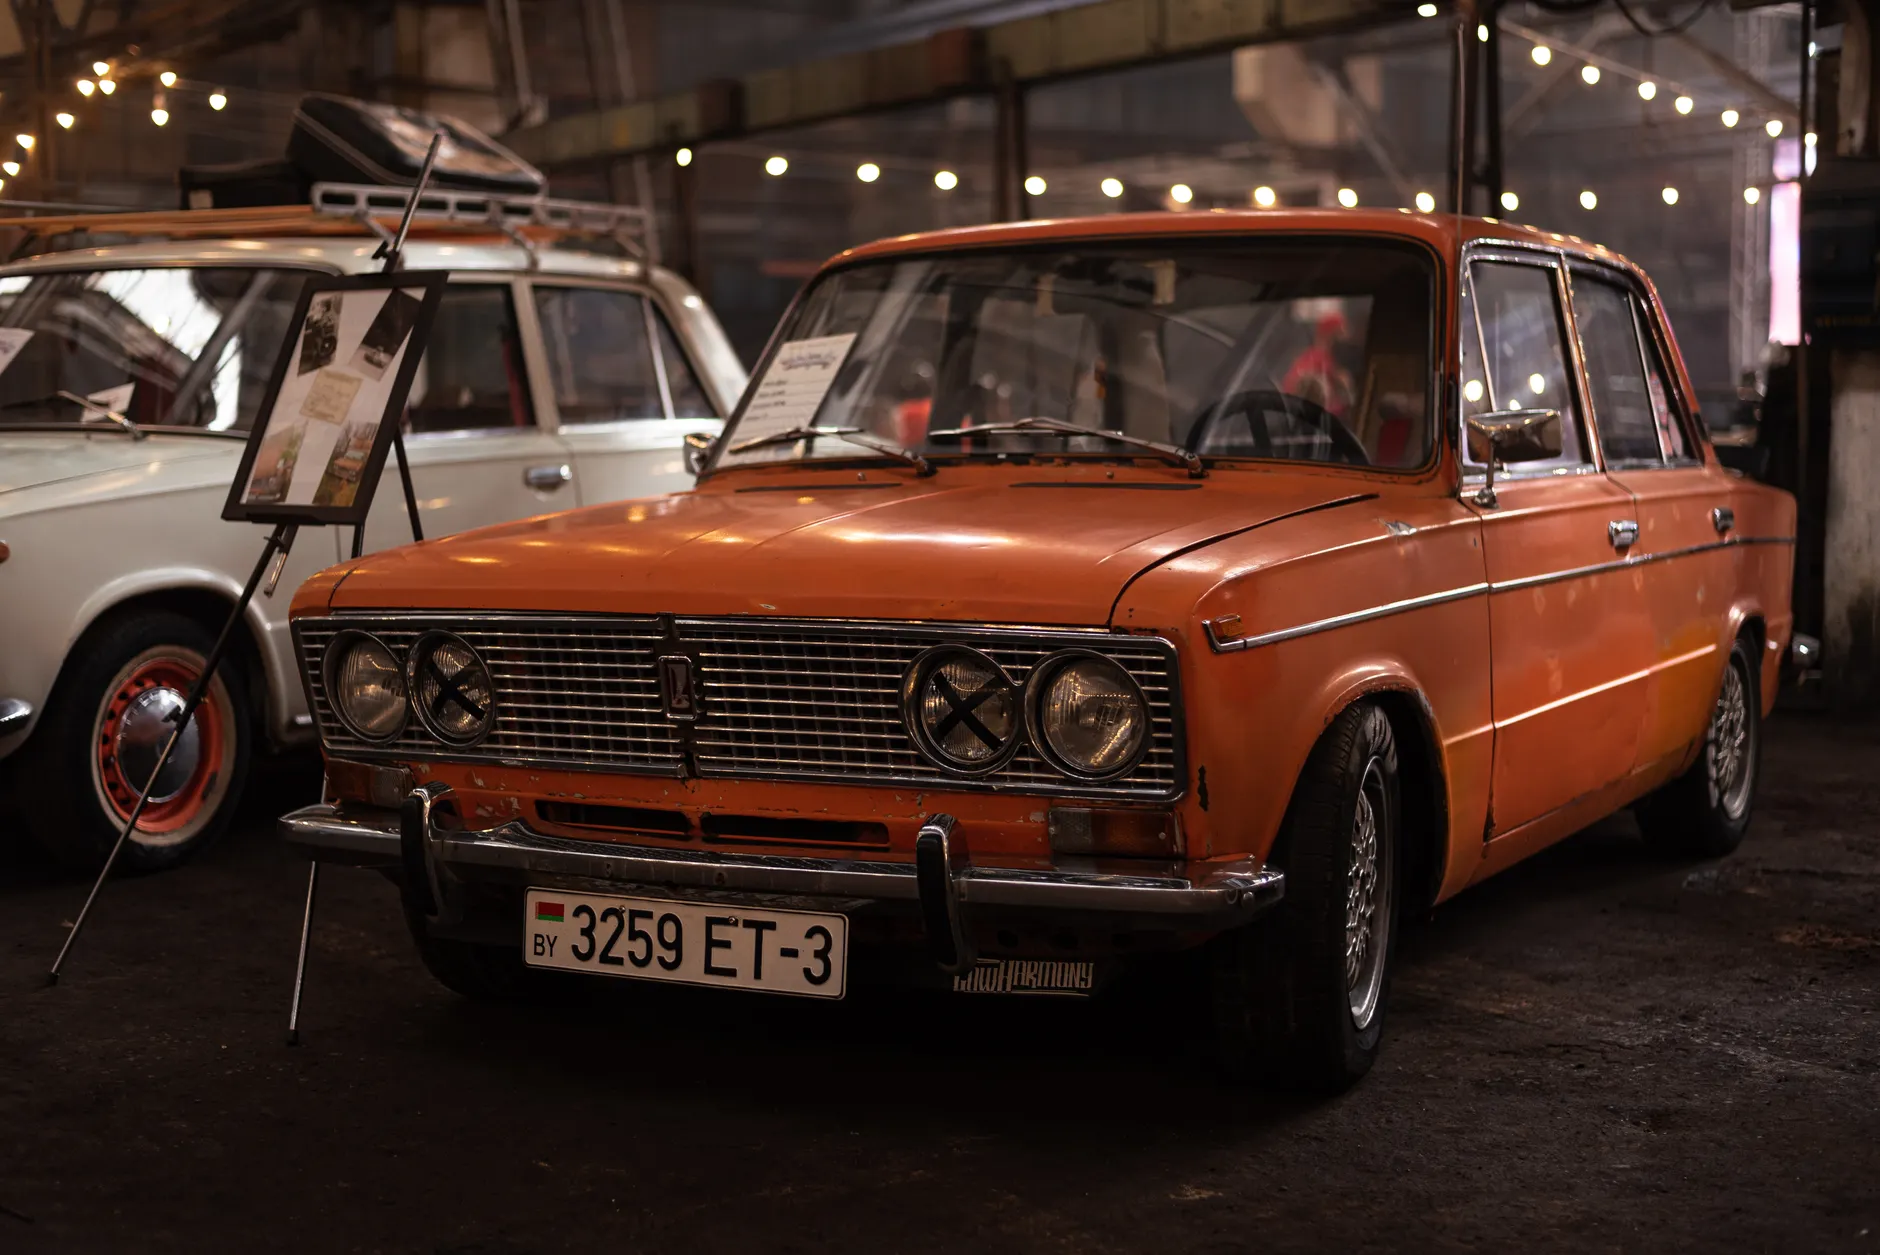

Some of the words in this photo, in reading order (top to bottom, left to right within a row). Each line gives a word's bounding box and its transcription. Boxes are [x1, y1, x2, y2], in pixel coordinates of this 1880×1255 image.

[533, 933, 558, 958] BY
[571, 904, 683, 971] 3259
[704, 916, 833, 985] ET-3
